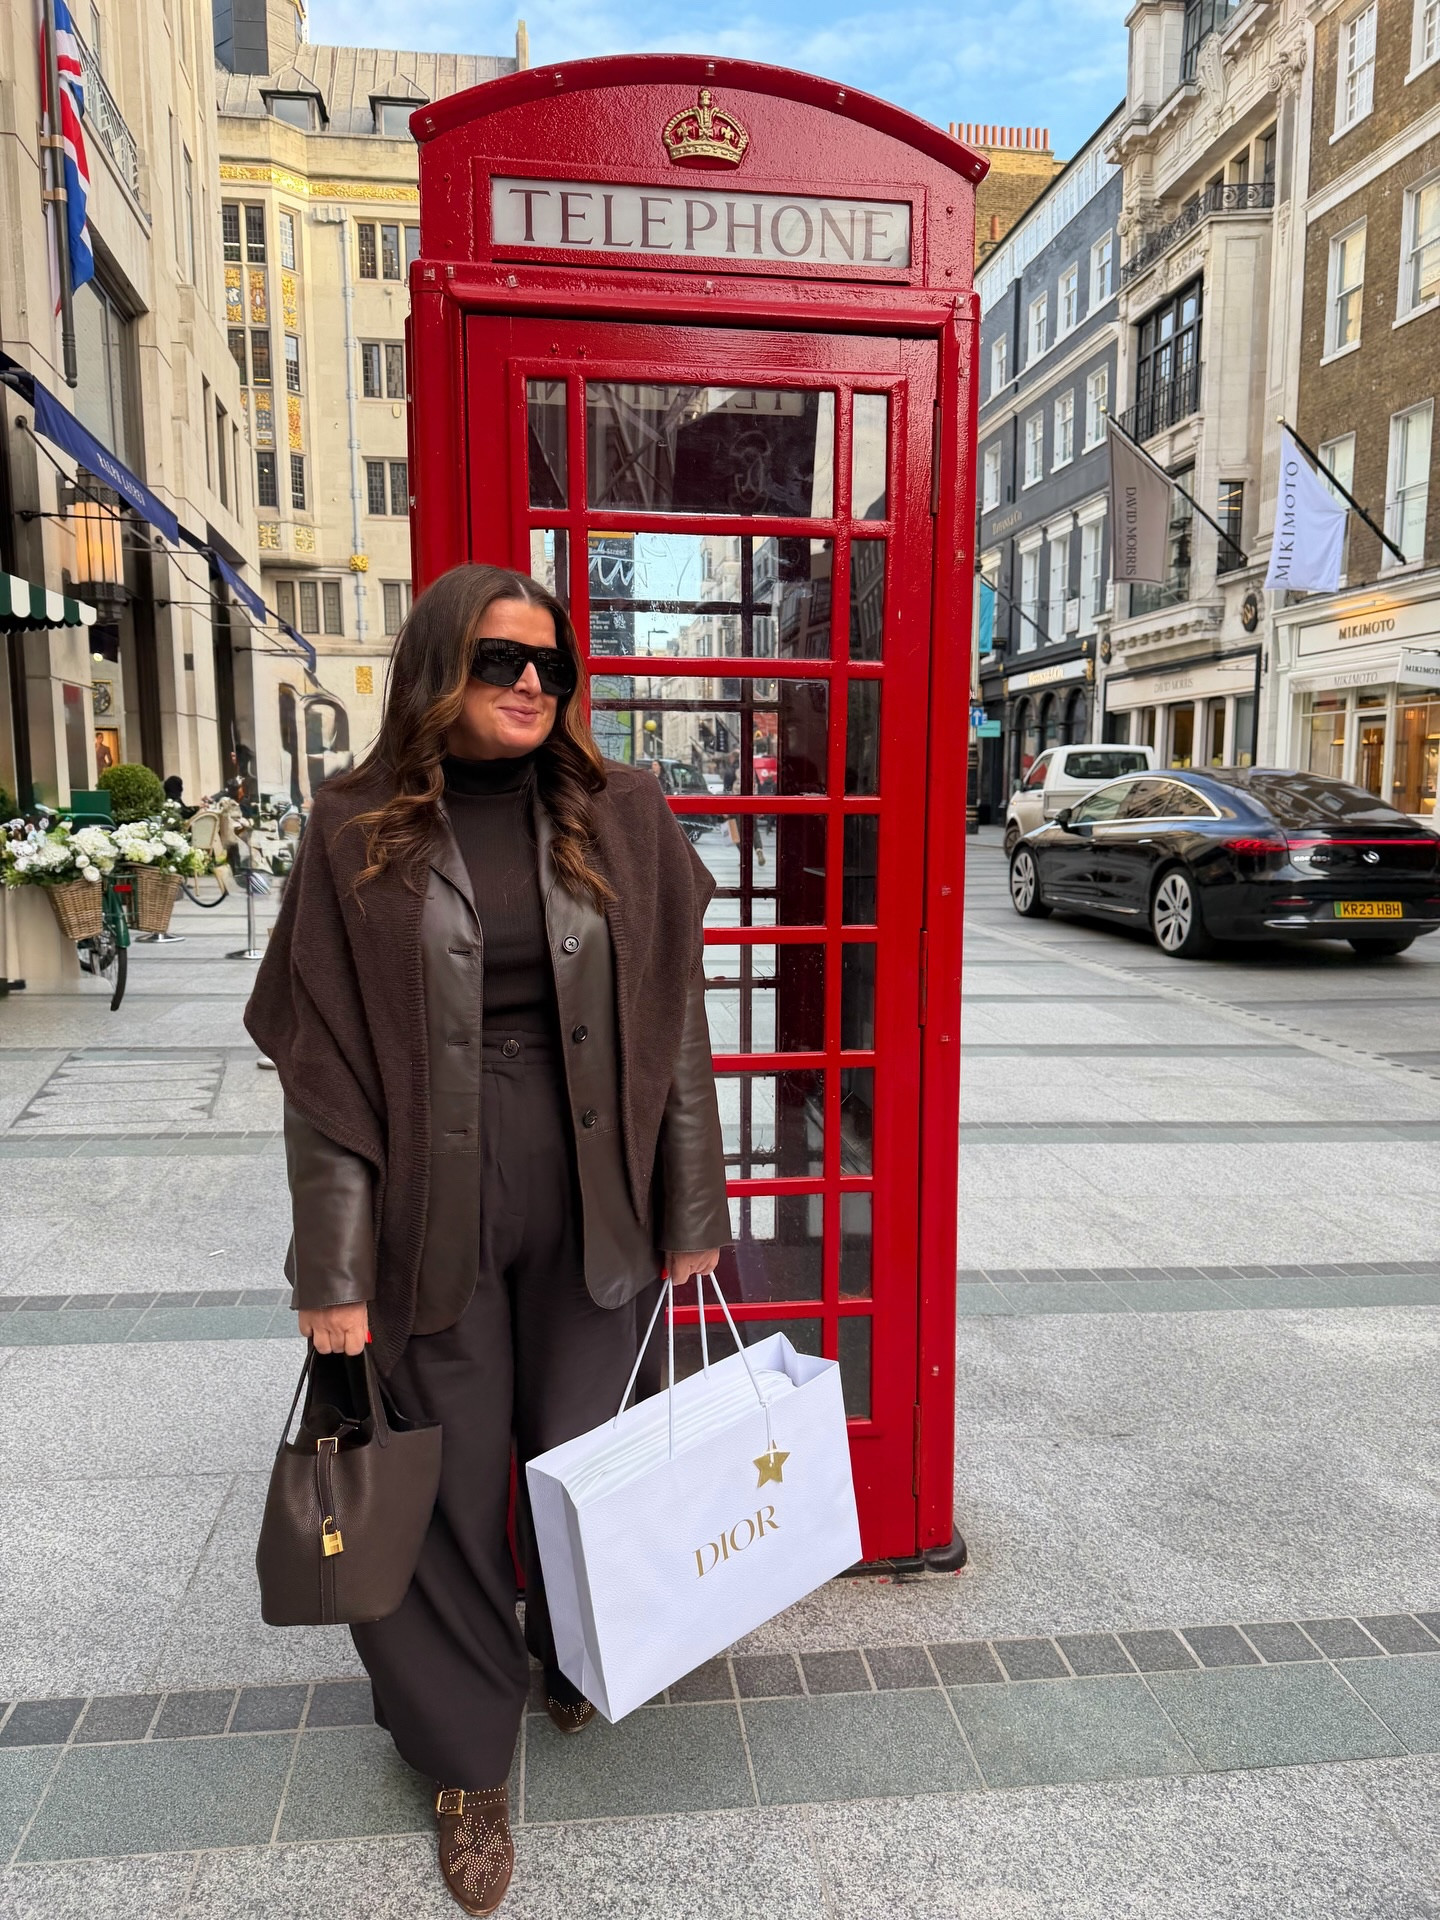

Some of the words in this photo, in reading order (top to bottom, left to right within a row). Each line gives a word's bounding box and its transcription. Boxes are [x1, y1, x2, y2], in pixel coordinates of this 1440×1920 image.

[509, 188, 894, 263] TELEPHONE
[1126, 486, 1137, 524] DAVID
[1274, 461, 1299, 580] MIKIMOTO
[1126, 526, 1137, 576] MORRIS
[1338, 618, 1395, 640] MIKIMOTO
[1334, 671, 1378, 686] MIKIMOTO
[1405, 664, 1440, 675] MIKIMOT
[1343, 903, 1374, 916] KR23
[1377, 903, 1401, 916] HBH
[692, 1505, 781, 1580] DIOR
